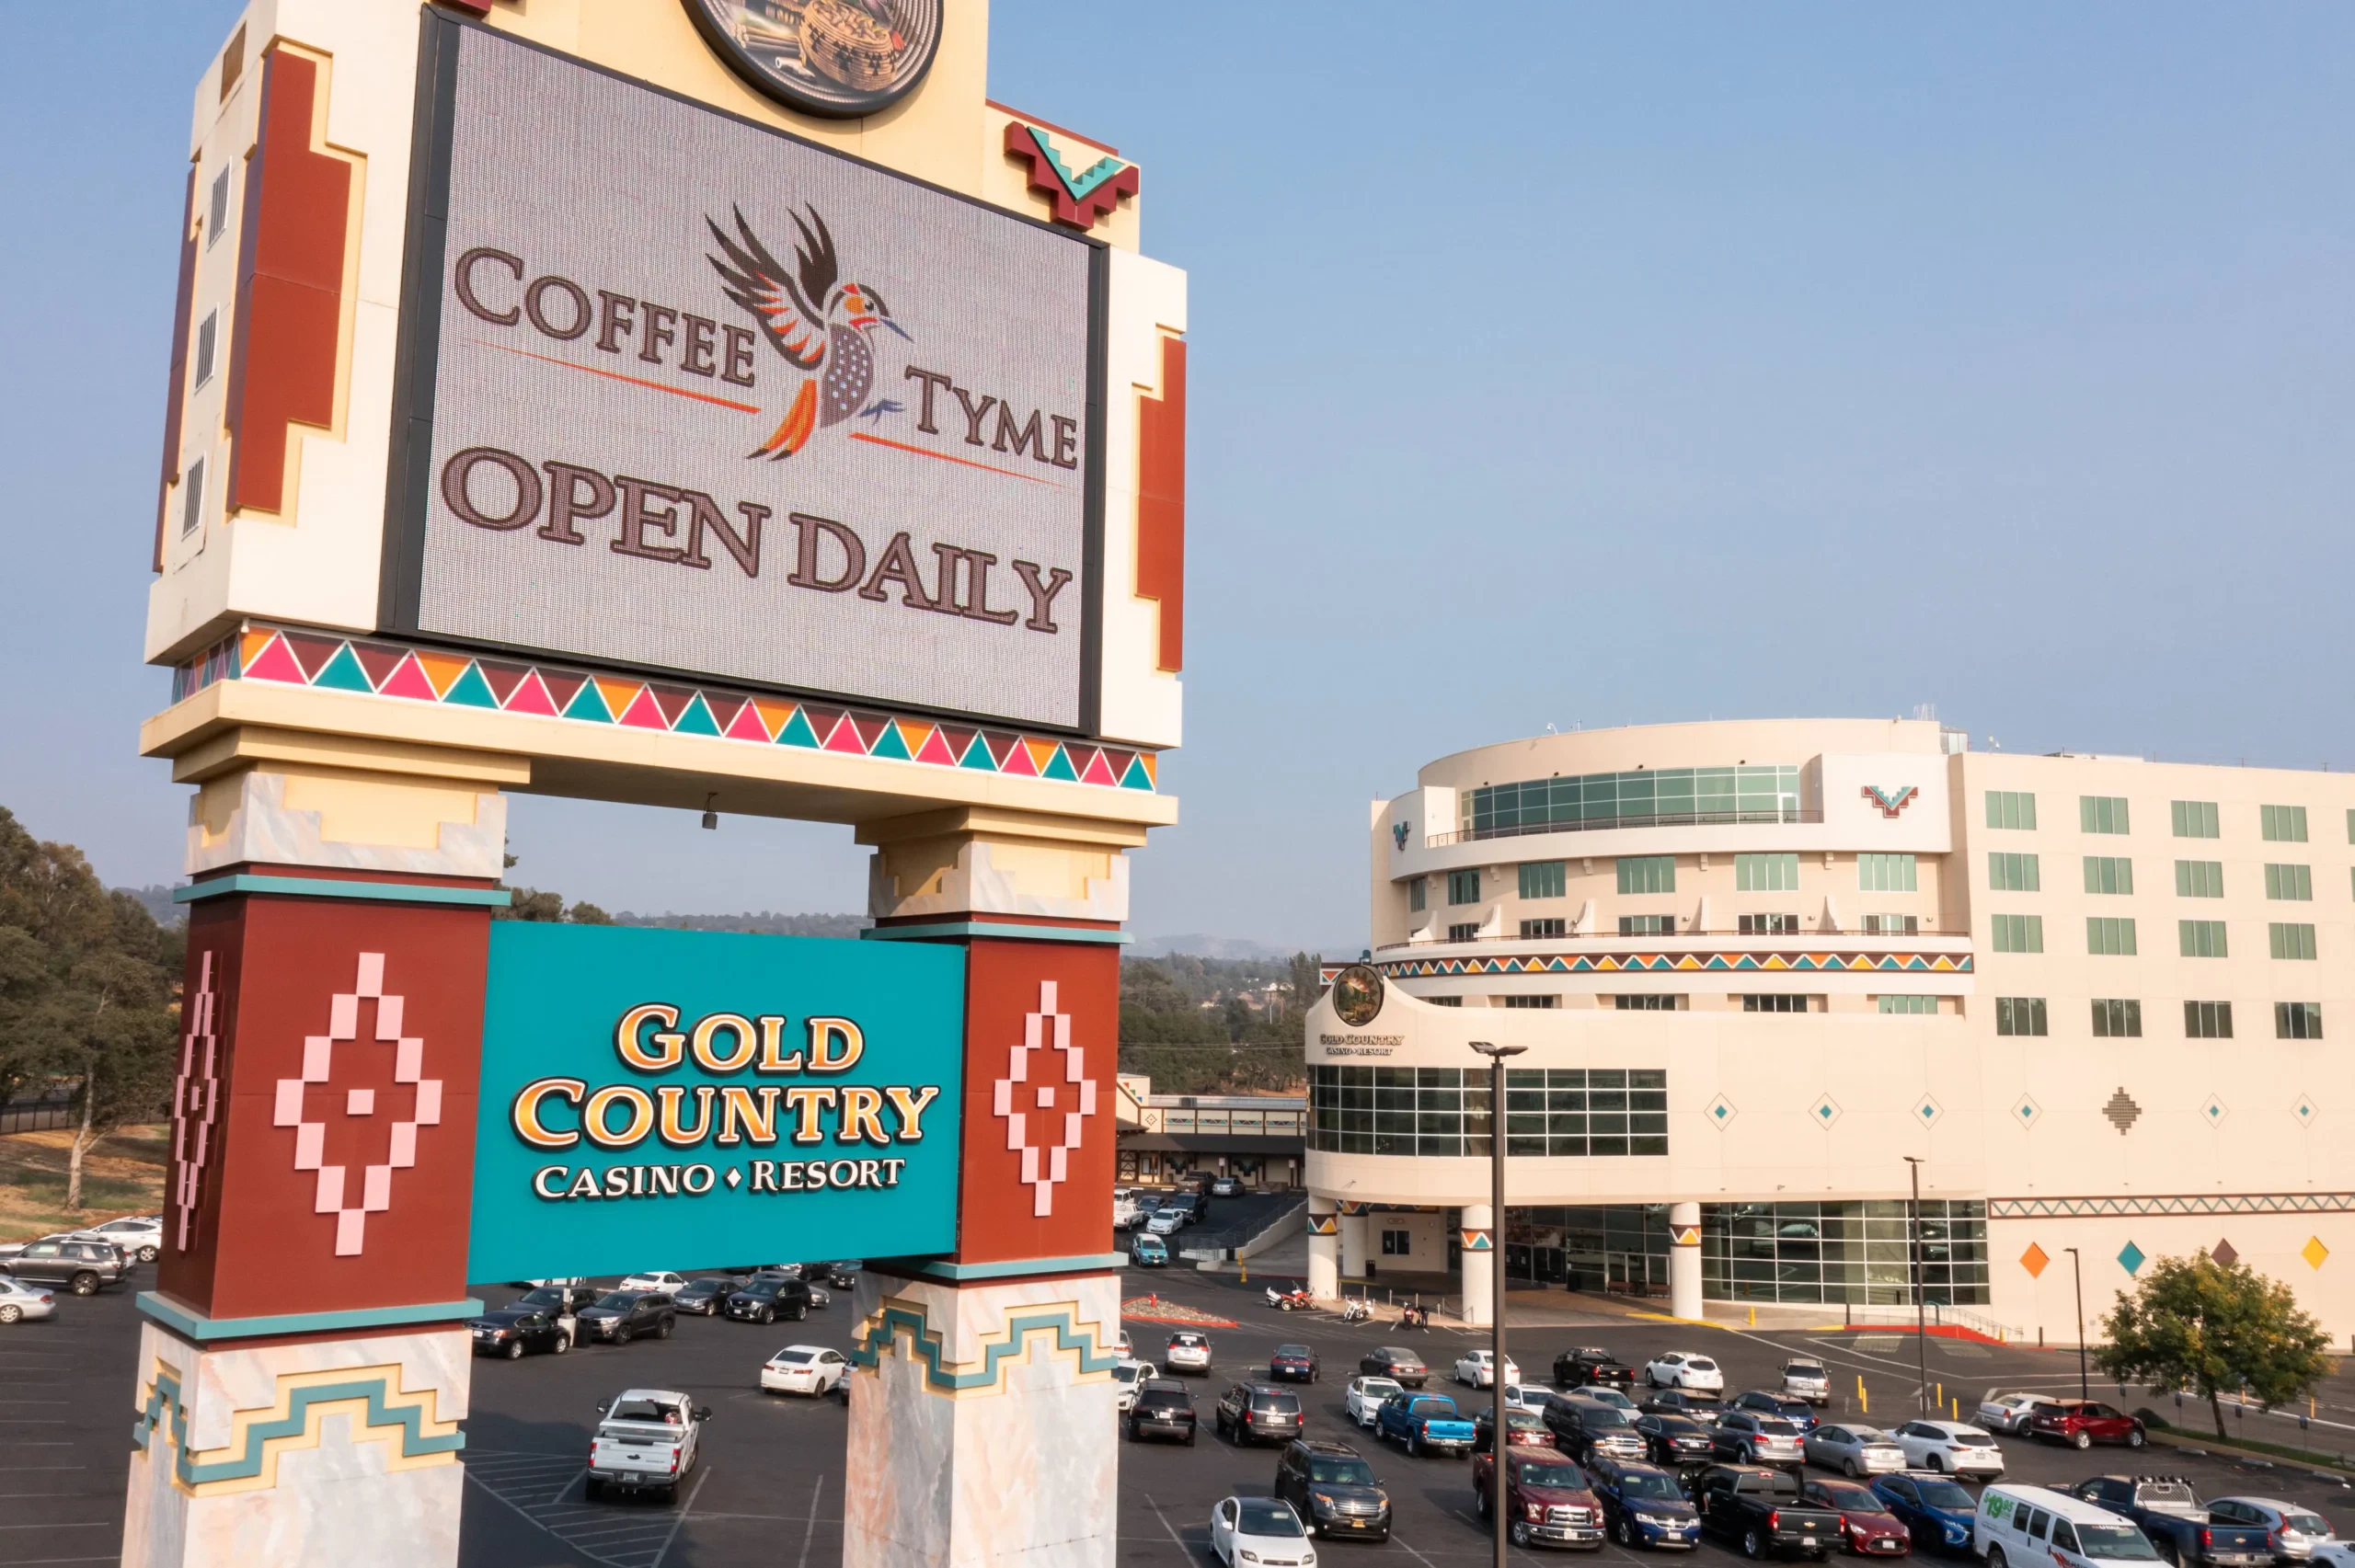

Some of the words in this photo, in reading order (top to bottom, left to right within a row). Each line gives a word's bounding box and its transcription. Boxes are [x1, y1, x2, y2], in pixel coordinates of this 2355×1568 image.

[454, 246, 755, 387] COFFEE
[905, 365, 1077, 470] TYME
[441, 446, 772, 578] OPEN
[787, 511, 1073, 635] DAILY
[613, 1001, 865, 1073] GOLD
[1345, 1034, 1405, 1046] COUNTRY
[509, 1076, 939, 1150] COUNTRY
[533, 1162, 716, 1199] CASINO
[749, 1158, 905, 1192] RESORT
